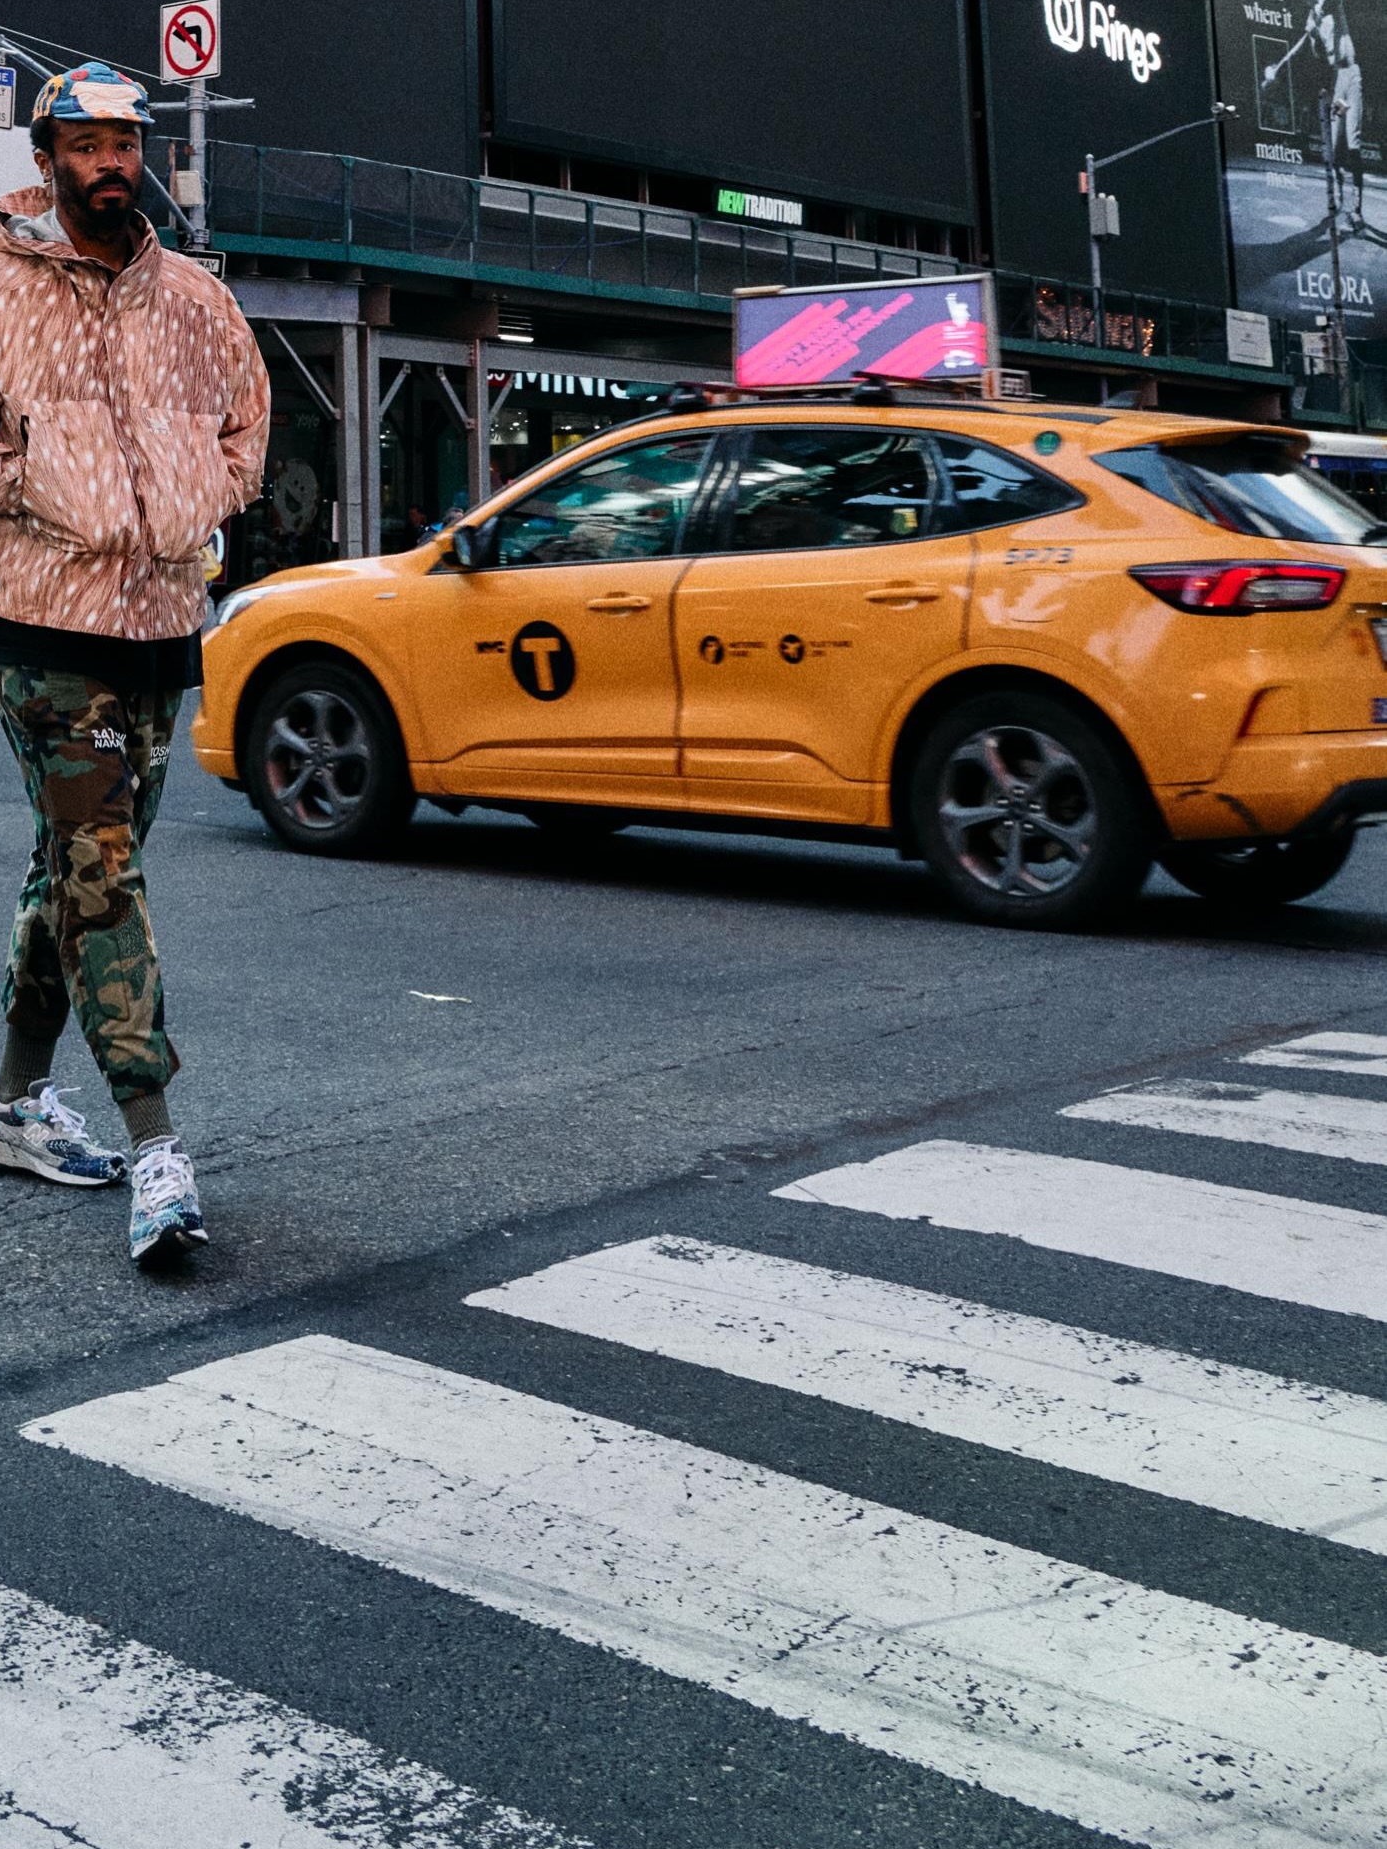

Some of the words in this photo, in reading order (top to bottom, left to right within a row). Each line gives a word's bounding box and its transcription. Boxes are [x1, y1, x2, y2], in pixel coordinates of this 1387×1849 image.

[1243, 2, 1282, 27] where
[1282, 8, 1293, 29] it
[1089, 1, 1162, 83] Rings
[1255, 142, 1303, 165] matters
[520, 637, 561, 692] T
